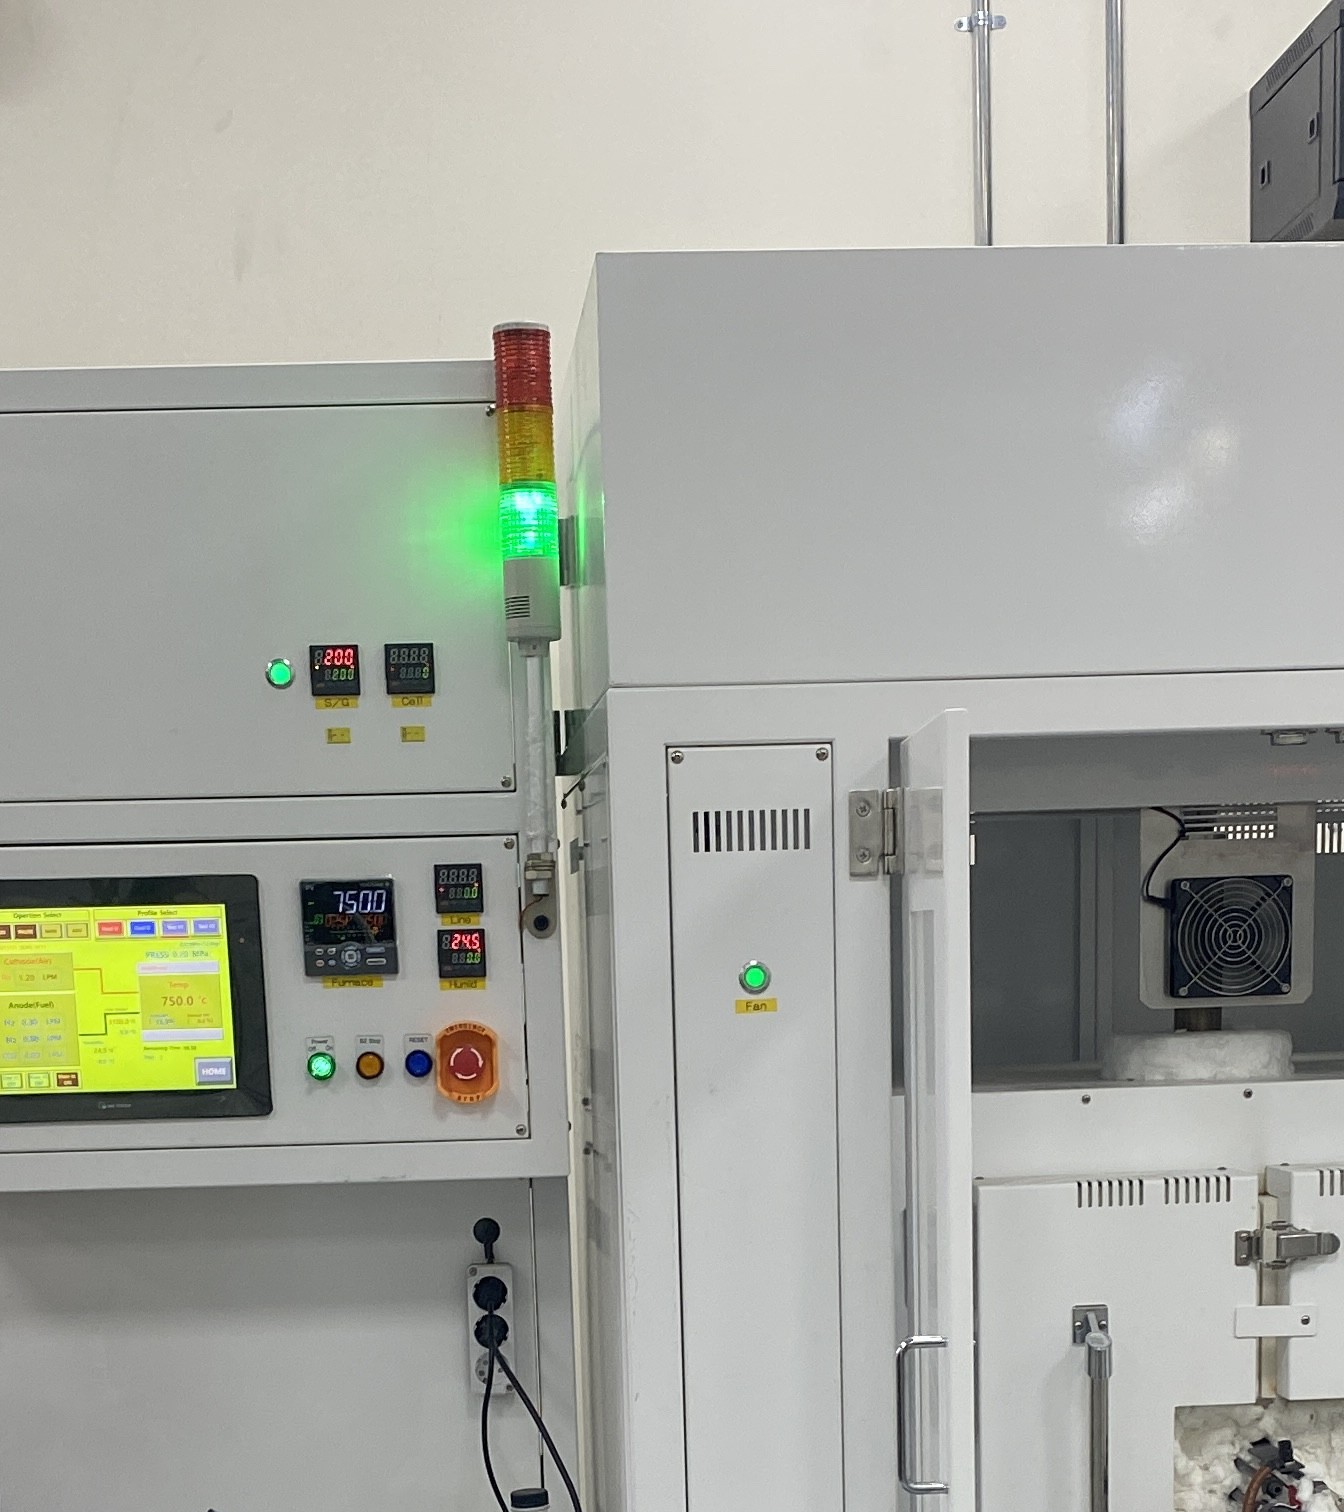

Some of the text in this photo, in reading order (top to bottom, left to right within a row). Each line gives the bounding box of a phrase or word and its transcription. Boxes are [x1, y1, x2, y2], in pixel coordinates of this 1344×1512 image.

[450, 916, 471, 924] Line
[161, 996, 193, 1007] 750.0
[746, 1002, 767, 1011] Fan
[201, 1067, 226, 1075] HOME
